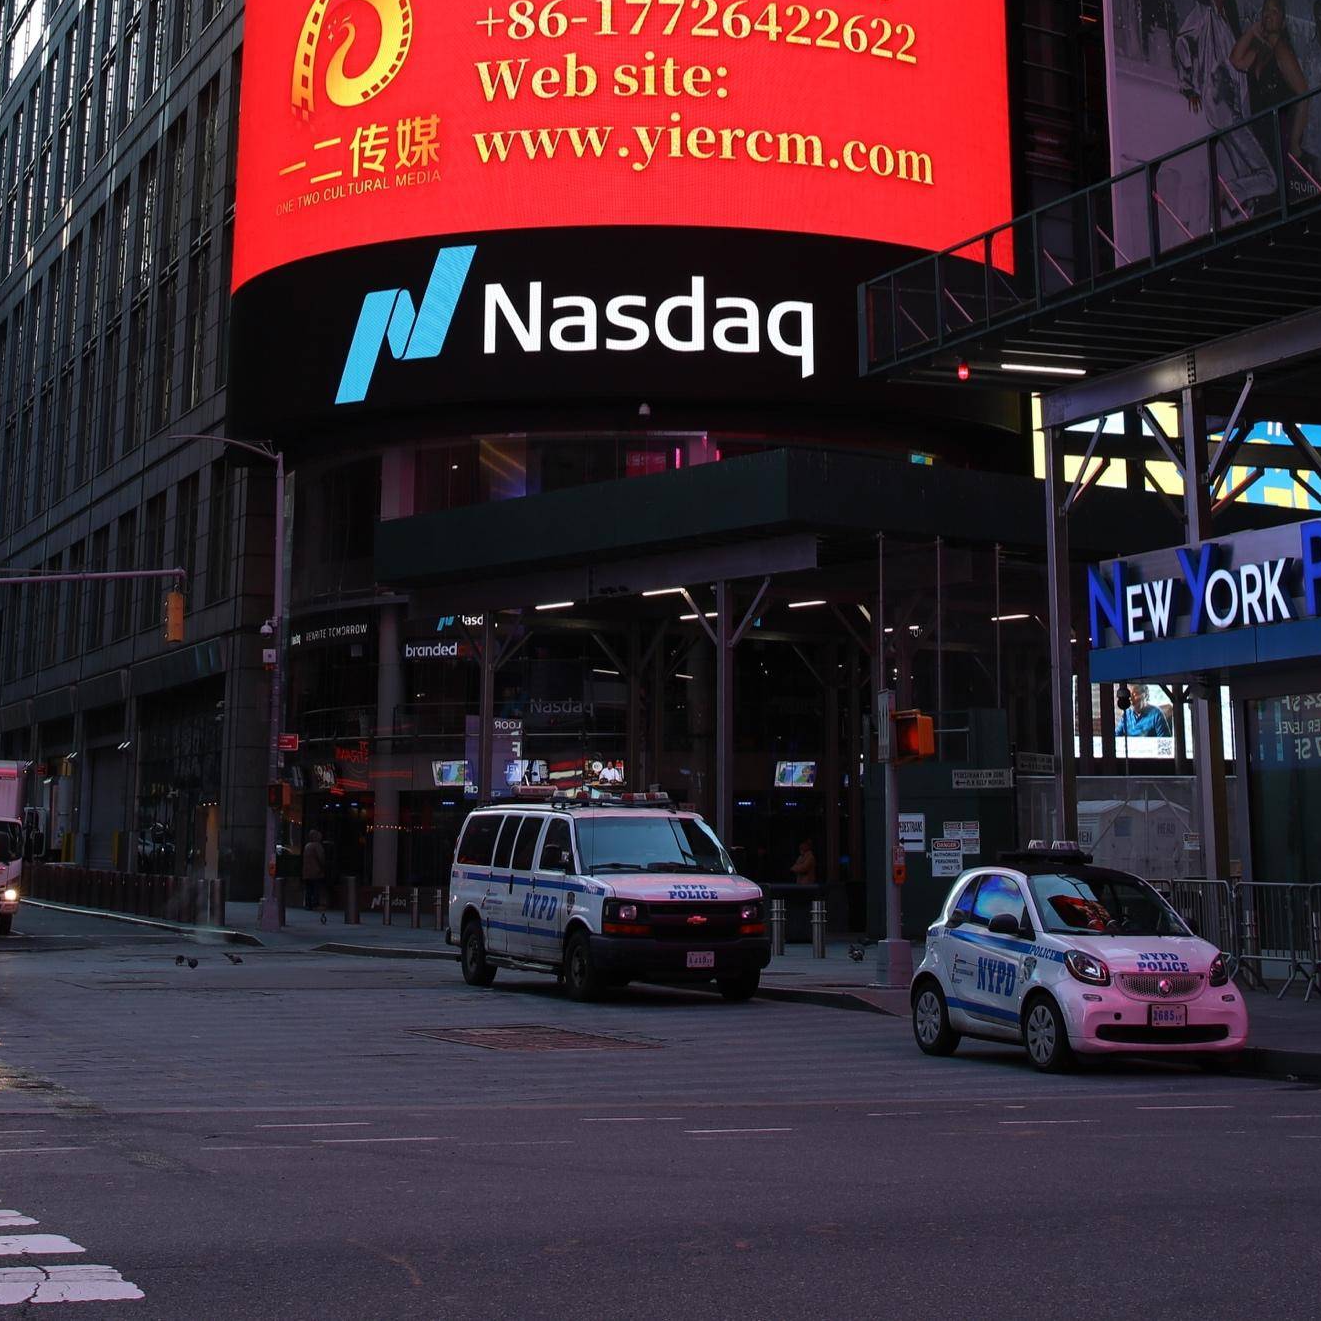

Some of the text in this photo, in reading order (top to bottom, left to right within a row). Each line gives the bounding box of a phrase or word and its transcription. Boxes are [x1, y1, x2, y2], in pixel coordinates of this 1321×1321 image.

[475, 51, 730, 103] Web site:
[279, 114, 441, 184] 一二传媒
[473, 113, 934, 186] www.yiercm.com
[276, 169, 442, 216] ONE TWO CULTURAL MEDIA
[483, 276, 815, 378] Nasdaq
[521, 893, 558, 921] NYPD
[668, 890, 718, 900] POLICE
[1029, 945, 1056, 961] POLICE
[1137, 961, 1190, 972] POLICE
[1138, 952, 1179, 961] NYPD
[977, 957, 1016, 997] NYPD
